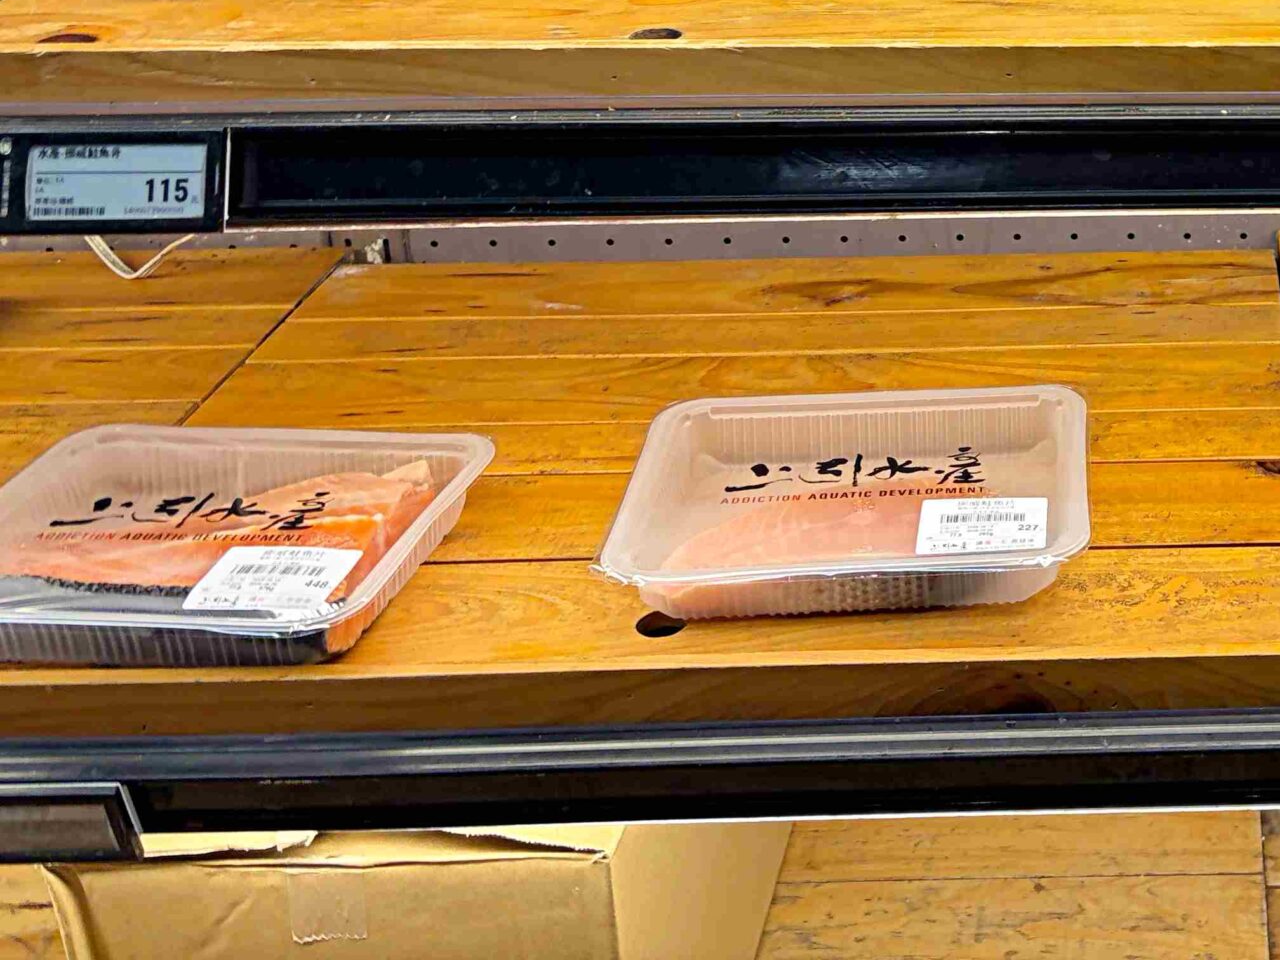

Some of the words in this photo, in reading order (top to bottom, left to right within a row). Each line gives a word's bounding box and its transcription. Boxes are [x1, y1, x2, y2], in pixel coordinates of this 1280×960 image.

[145, 178, 189, 203] 115
[720, 493, 802, 505] ADDICTION
[807, 490, 872, 501] AQUATIC
[878, 486, 986, 498] DEVELOPMENT
[1017, 523, 1040, 532] 227
[36, 531, 116, 541] ADDICTION
[122, 532, 188, 541] AQUATIC
[192, 533, 305, 542] DEVELOPMENT
